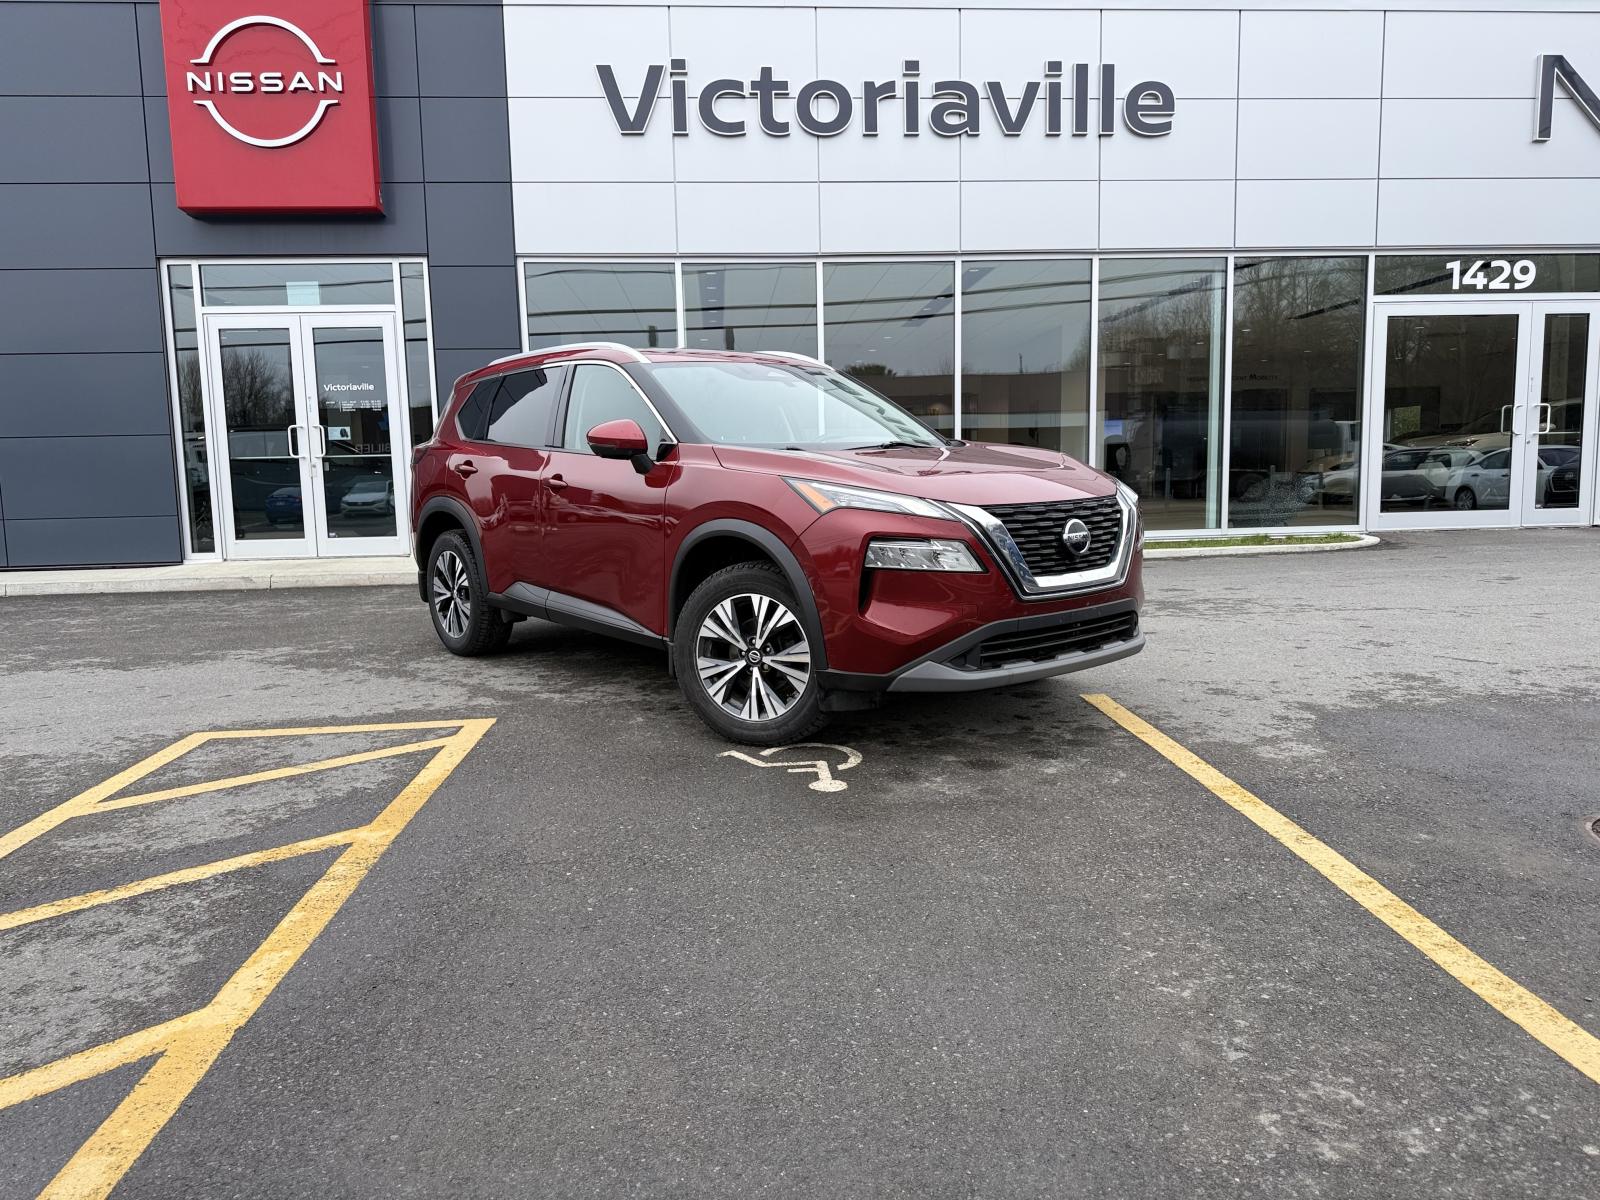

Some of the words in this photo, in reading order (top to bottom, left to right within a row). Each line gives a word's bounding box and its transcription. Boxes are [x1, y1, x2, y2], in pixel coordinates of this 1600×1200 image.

[186, 71, 343, 93] NISSAN
[595, 58, 1176, 137] Victoriaville
[1445, 259, 1537, 290] 1429
[323, 383, 375, 392] Victoriaville
